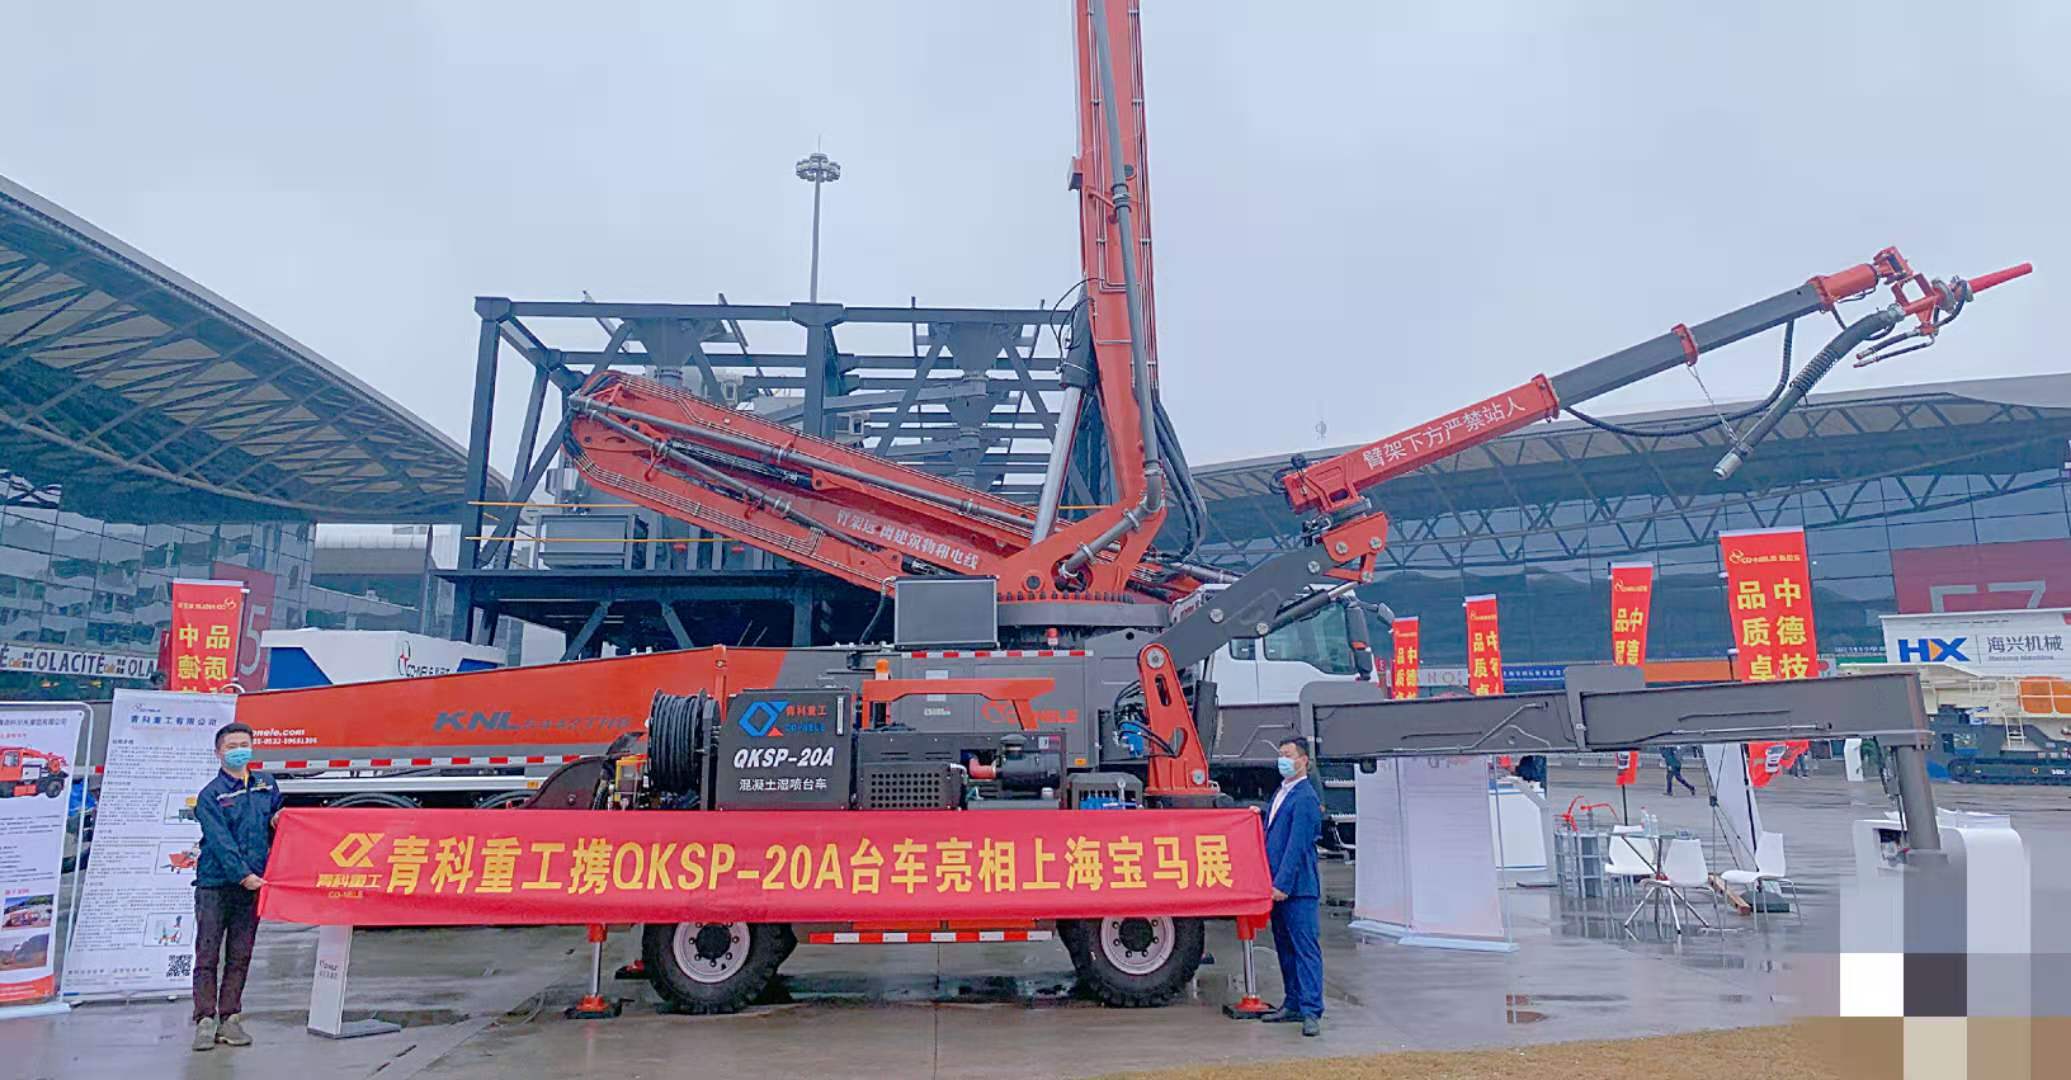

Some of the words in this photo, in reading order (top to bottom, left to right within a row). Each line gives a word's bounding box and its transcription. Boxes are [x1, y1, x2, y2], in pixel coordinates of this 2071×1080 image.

[1362, 395, 1526, 470] 臂架下方严禁站人
[1898, 636, 1970, 663] HX
[1986, 634, 2065, 653] 海兴机械
[432, 711, 519, 732] KNL
[733, 747, 834, 769] QKSP-20A
[385, 834, 1234, 895] 青科重工携QKSP-20A台车亮相上海宝马展
